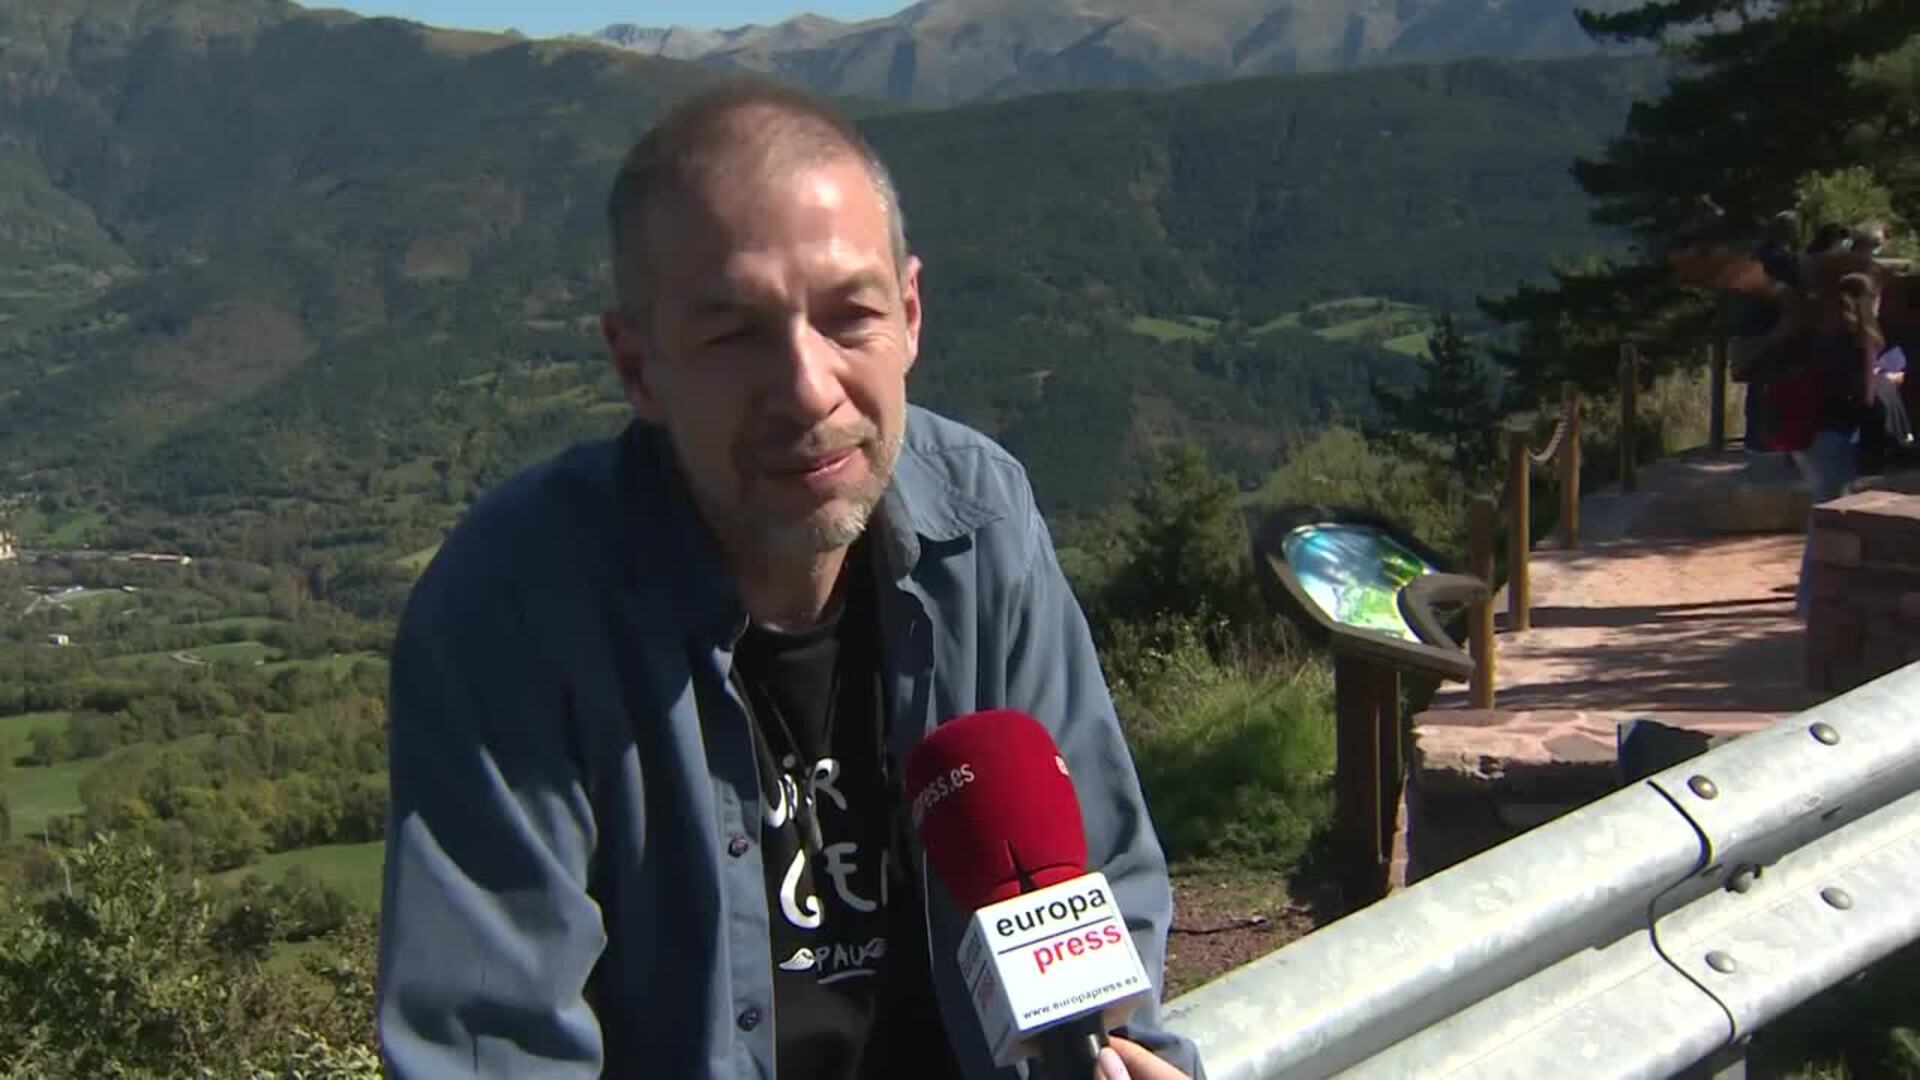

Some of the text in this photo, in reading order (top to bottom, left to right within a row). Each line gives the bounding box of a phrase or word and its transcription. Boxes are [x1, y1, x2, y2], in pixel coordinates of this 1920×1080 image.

[996, 887, 1107, 937] europa
[1033, 924, 1122, 975] press
[1023, 975, 1139, 1019] www.europapress.es
